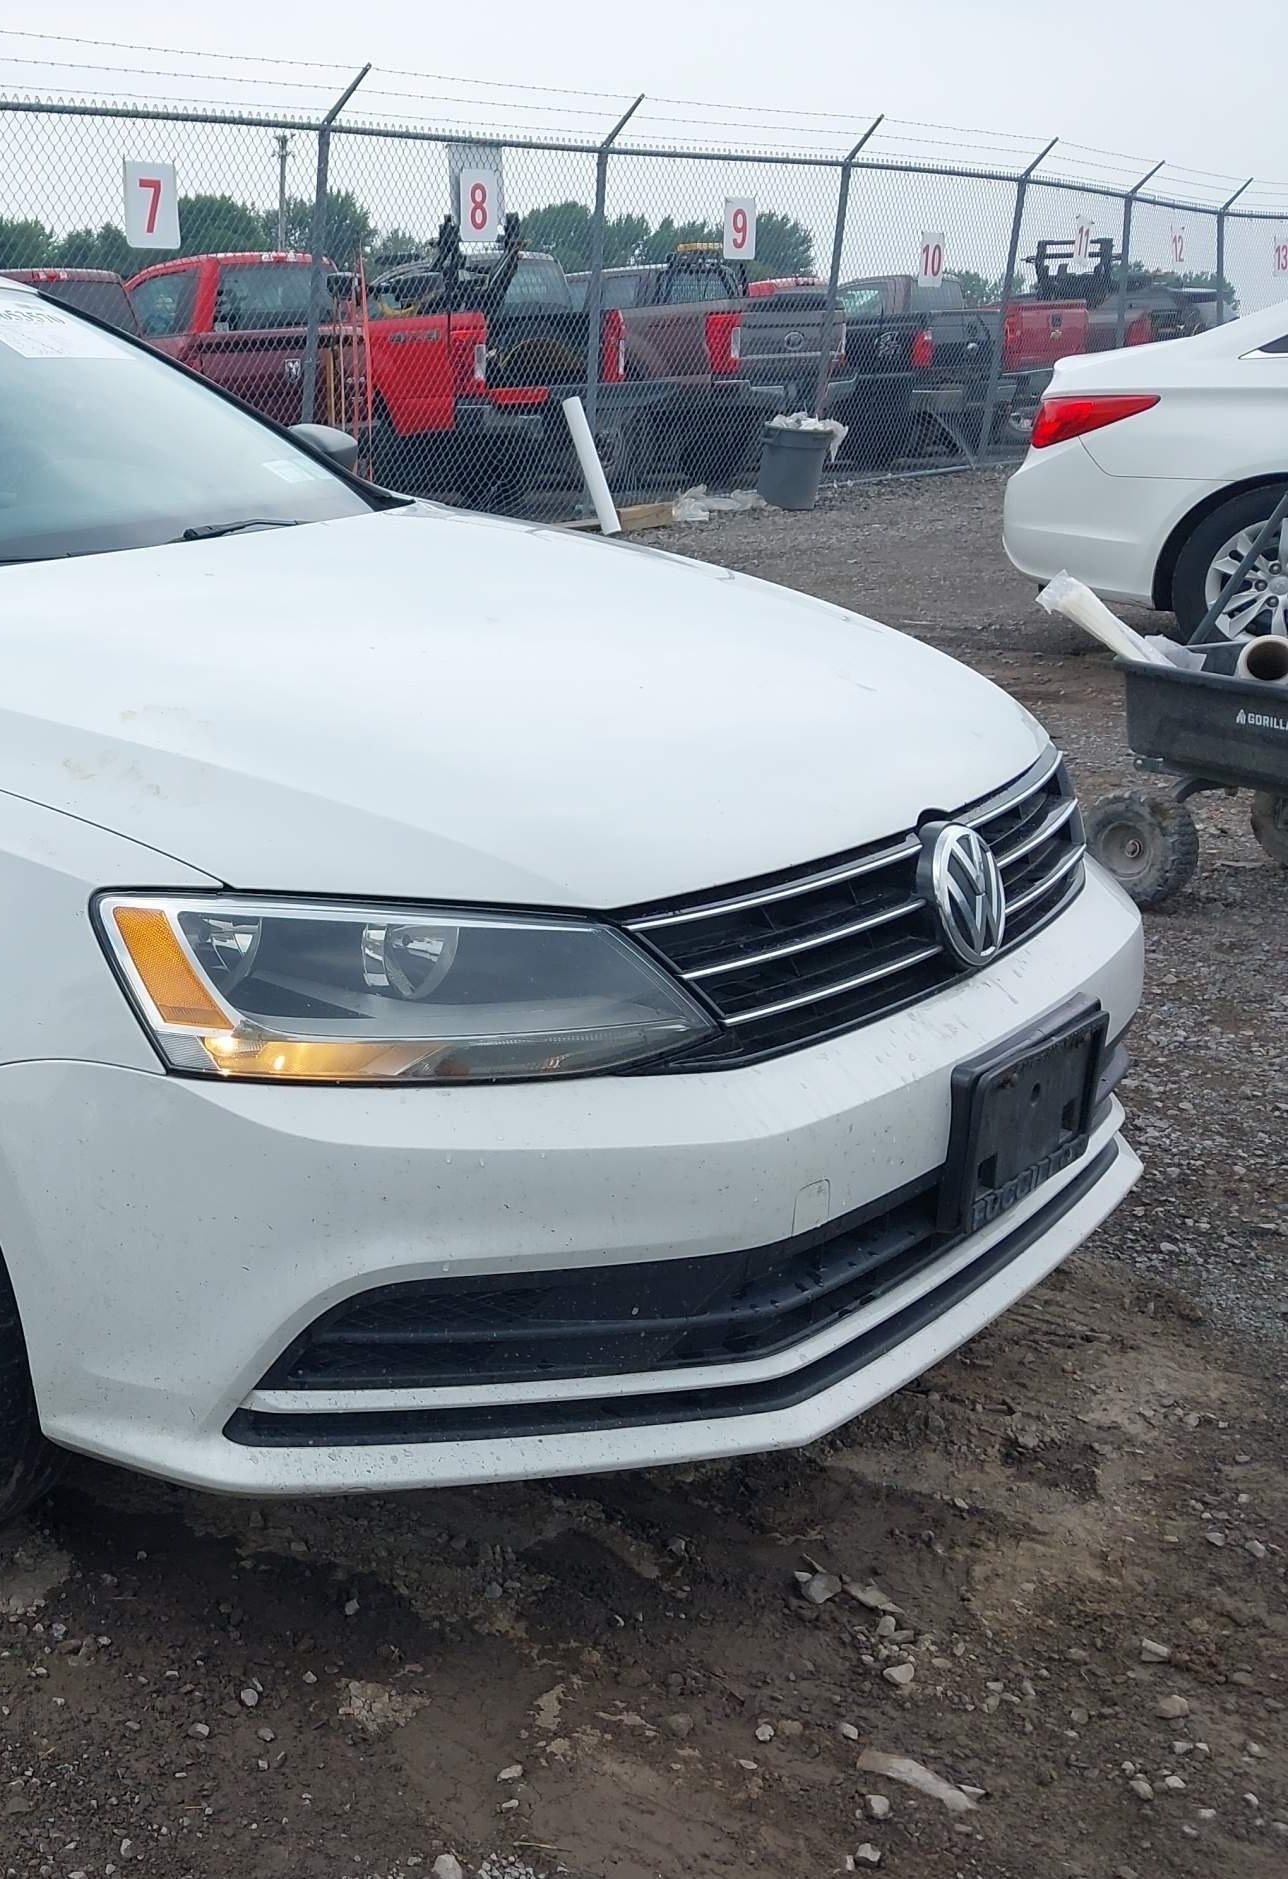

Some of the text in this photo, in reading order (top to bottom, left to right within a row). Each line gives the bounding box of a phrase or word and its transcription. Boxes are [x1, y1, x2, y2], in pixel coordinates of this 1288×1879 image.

[139, 178, 162, 234] 7
[470, 182, 488, 230] 8
[732, 208, 747, 249] 9
[1077, 225, 1090, 259] 11
[922, 243, 942, 277] 10
[1172, 234, 1185, 263] 12
[1274, 244, 1288, 271] 13
